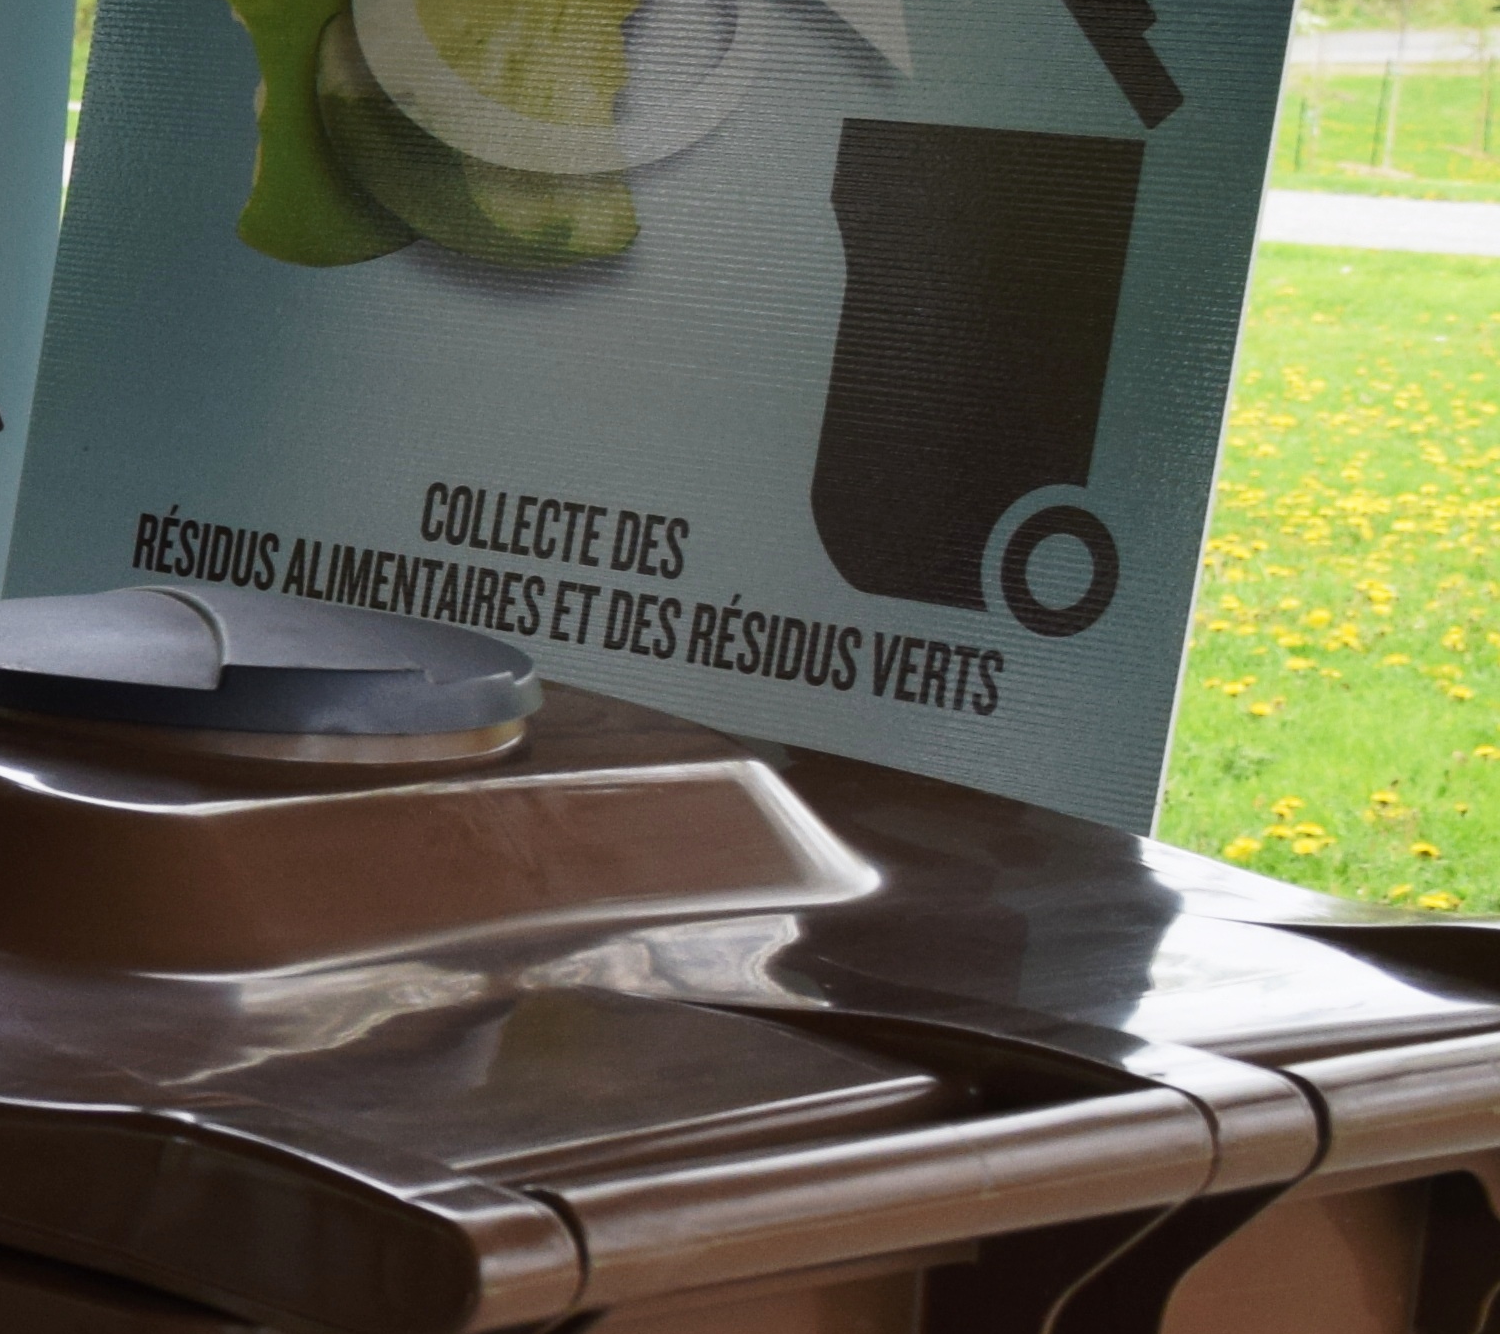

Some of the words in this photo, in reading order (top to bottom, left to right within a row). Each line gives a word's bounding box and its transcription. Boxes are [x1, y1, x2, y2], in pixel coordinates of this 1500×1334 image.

[421, 481, 606, 559] COLLECTE
[611, 513, 690, 579] DES
[132, 504, 279, 591] RÉSIDUS
[282, 538, 545, 636] ALIMENTAIRES
[550, 580, 595, 644] ET
[602, 591, 683, 660] DES
[687, 592, 863, 693] RÉSIDUS
[872, 631, 1005, 717] VERTS
